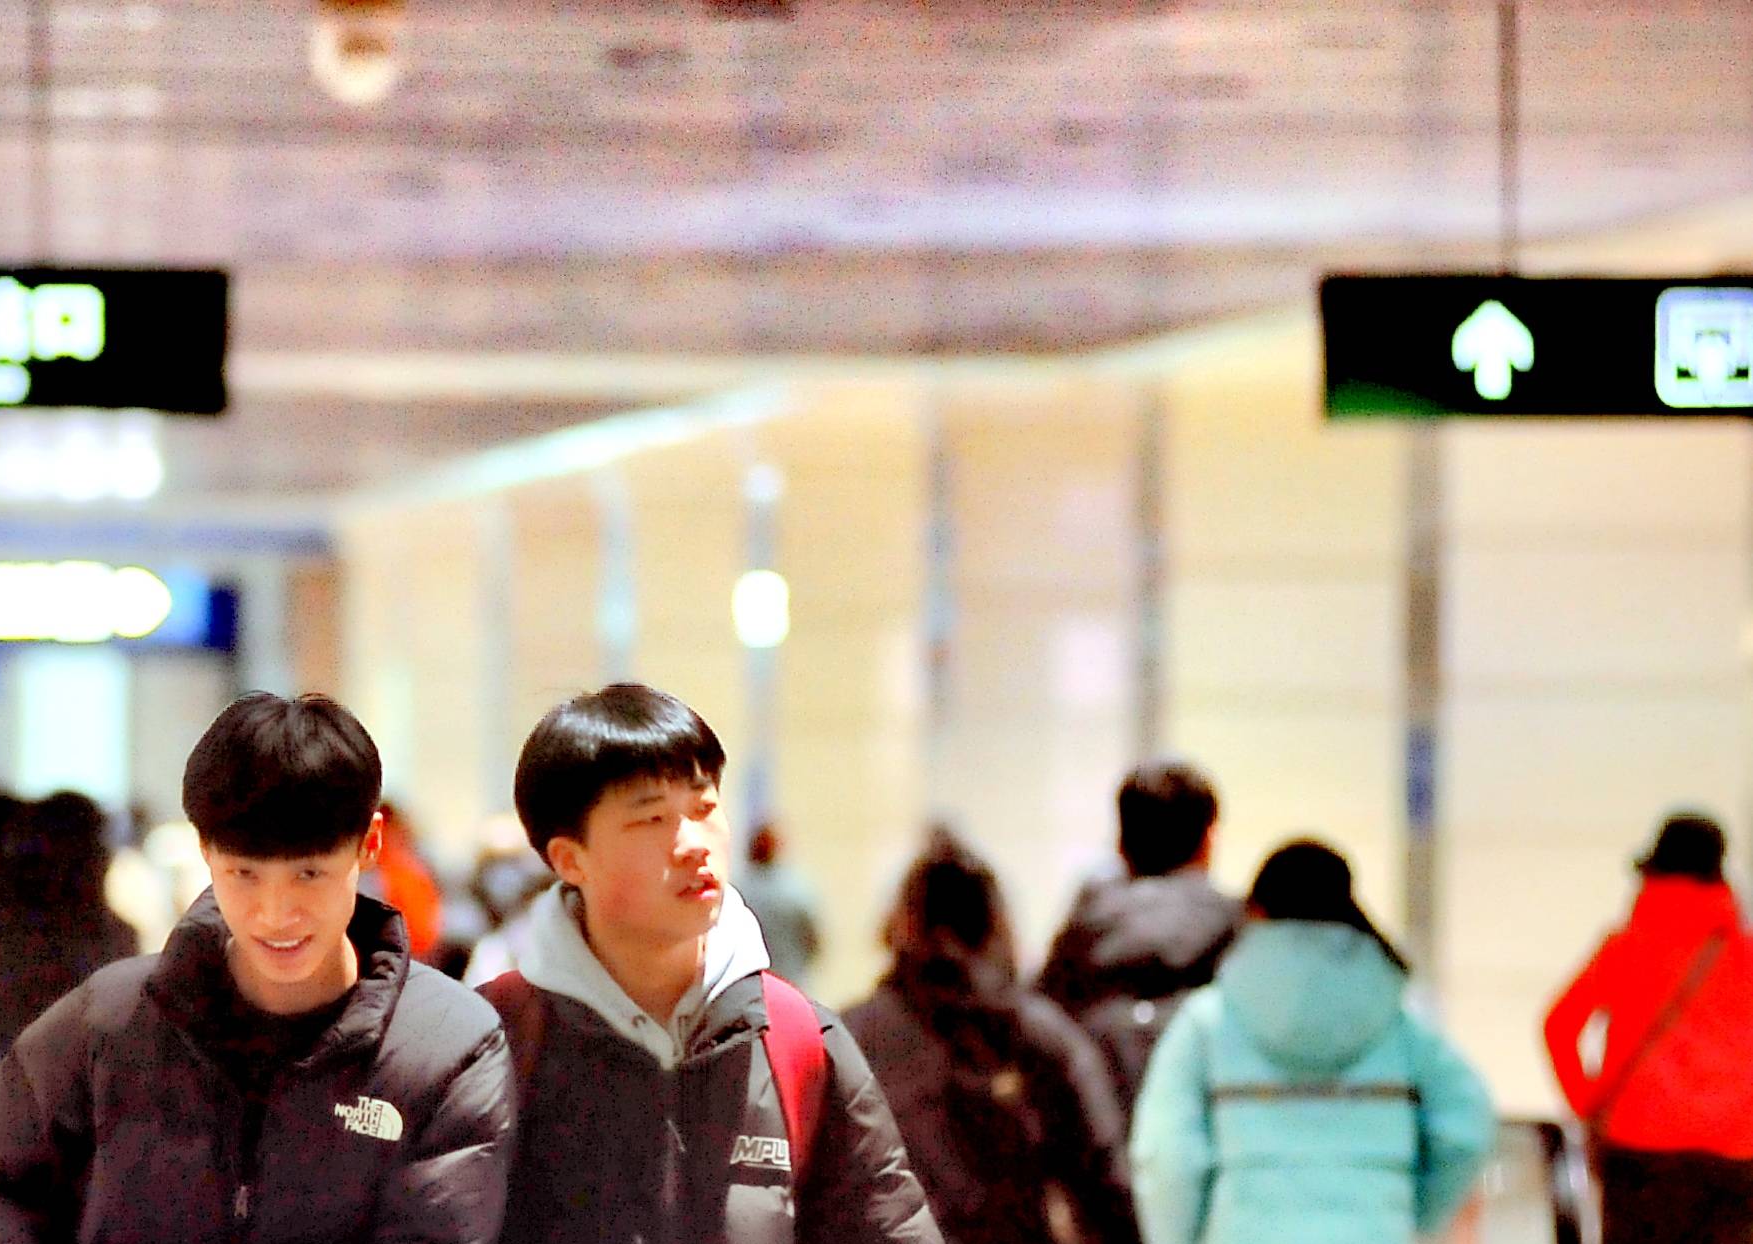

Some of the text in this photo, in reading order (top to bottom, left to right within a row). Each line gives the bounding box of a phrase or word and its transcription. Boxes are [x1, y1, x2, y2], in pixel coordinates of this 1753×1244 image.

[357, 1095, 383, 1112] THE
[334, 1102, 380, 1126] NORTH
[344, 1117, 378, 1136] FACE
